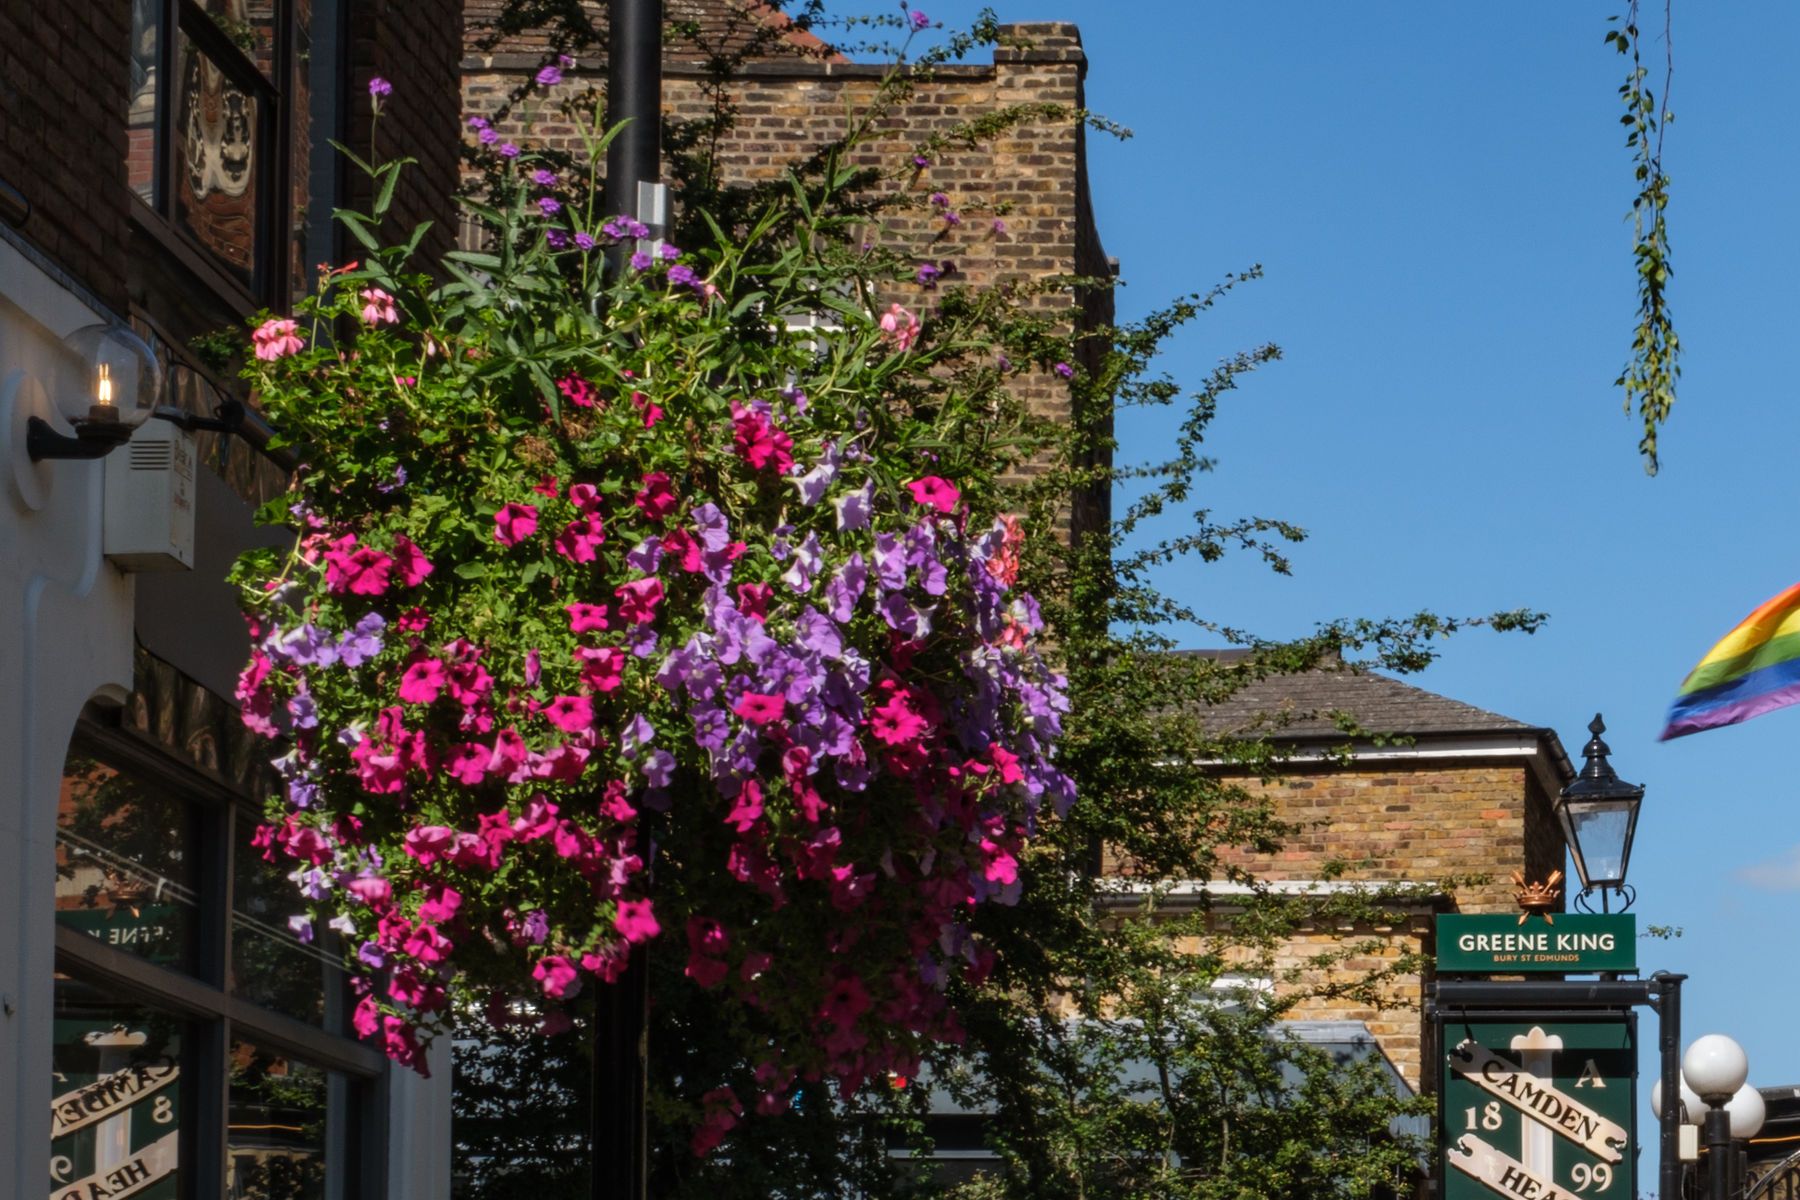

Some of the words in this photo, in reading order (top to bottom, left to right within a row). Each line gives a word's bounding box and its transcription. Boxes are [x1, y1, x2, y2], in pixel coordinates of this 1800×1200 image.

[1459, 934, 1548, 951] GREENE
[1557, 934, 1615, 951] KING
[1493, 954, 1517, 962] BURY
[1521, 954, 1531, 962] ST
[1534, 954, 1580, 962] EDMUNDS
[1574, 1058, 1606, 1089] A
[1481, 1060, 1600, 1141] CAMDEN
[1464, 1101, 1503, 1131] 18
[1571, 1163, 1613, 1193] 99
